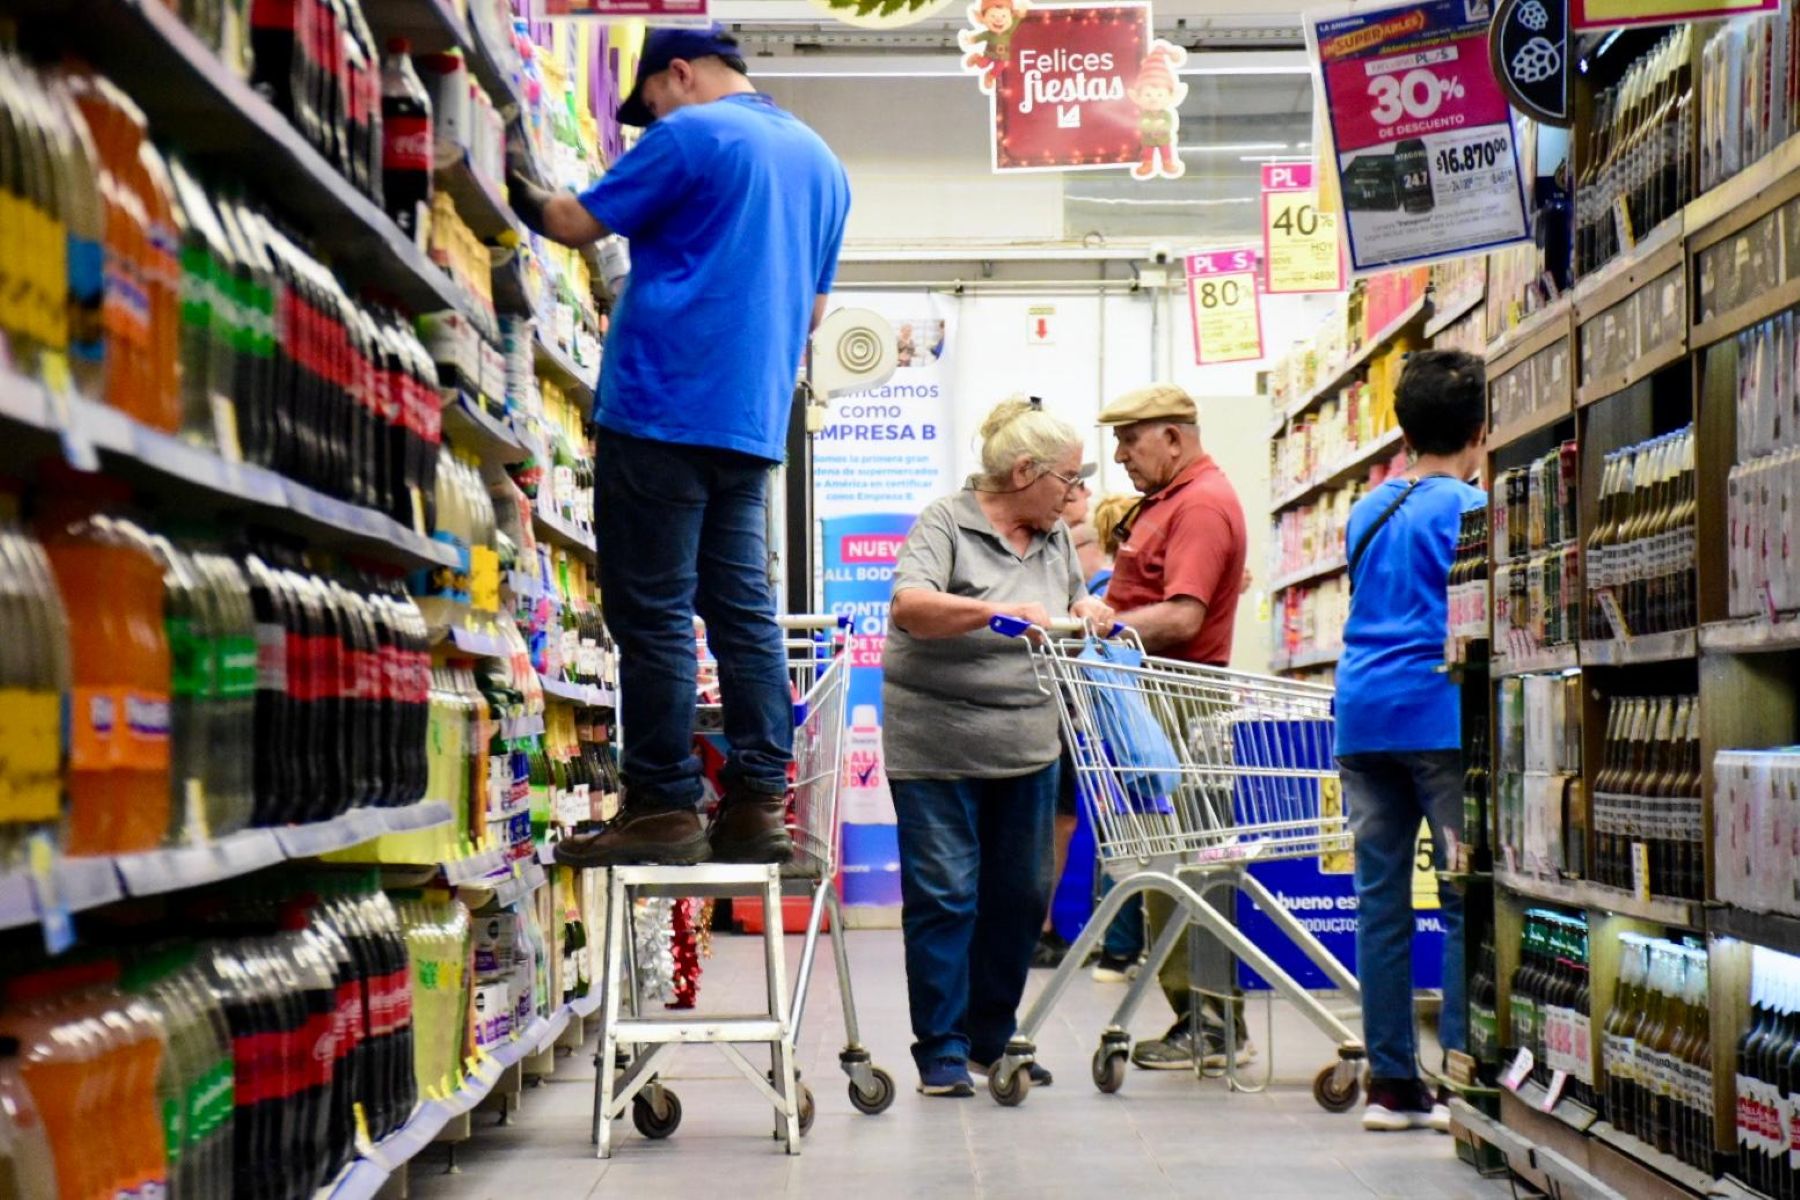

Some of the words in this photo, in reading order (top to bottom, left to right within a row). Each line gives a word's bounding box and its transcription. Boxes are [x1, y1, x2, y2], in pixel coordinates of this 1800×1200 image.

[1019, 48, 1114, 73] Felices
[1018, 69, 1125, 114] fiestas
[1367, 68, 1465, 125] 30%
[1379, 127, 1394, 138] DE
[1397, 114, 1465, 135] DESCUENTO
[840, 405, 902, 418] como
[922, 424, 936, 440] B
[825, 568, 853, 580] ALL
[1416, 838, 1434, 871] 5
[1277, 890, 1334, 910] bueno
[1336, 895, 1360, 910] es
